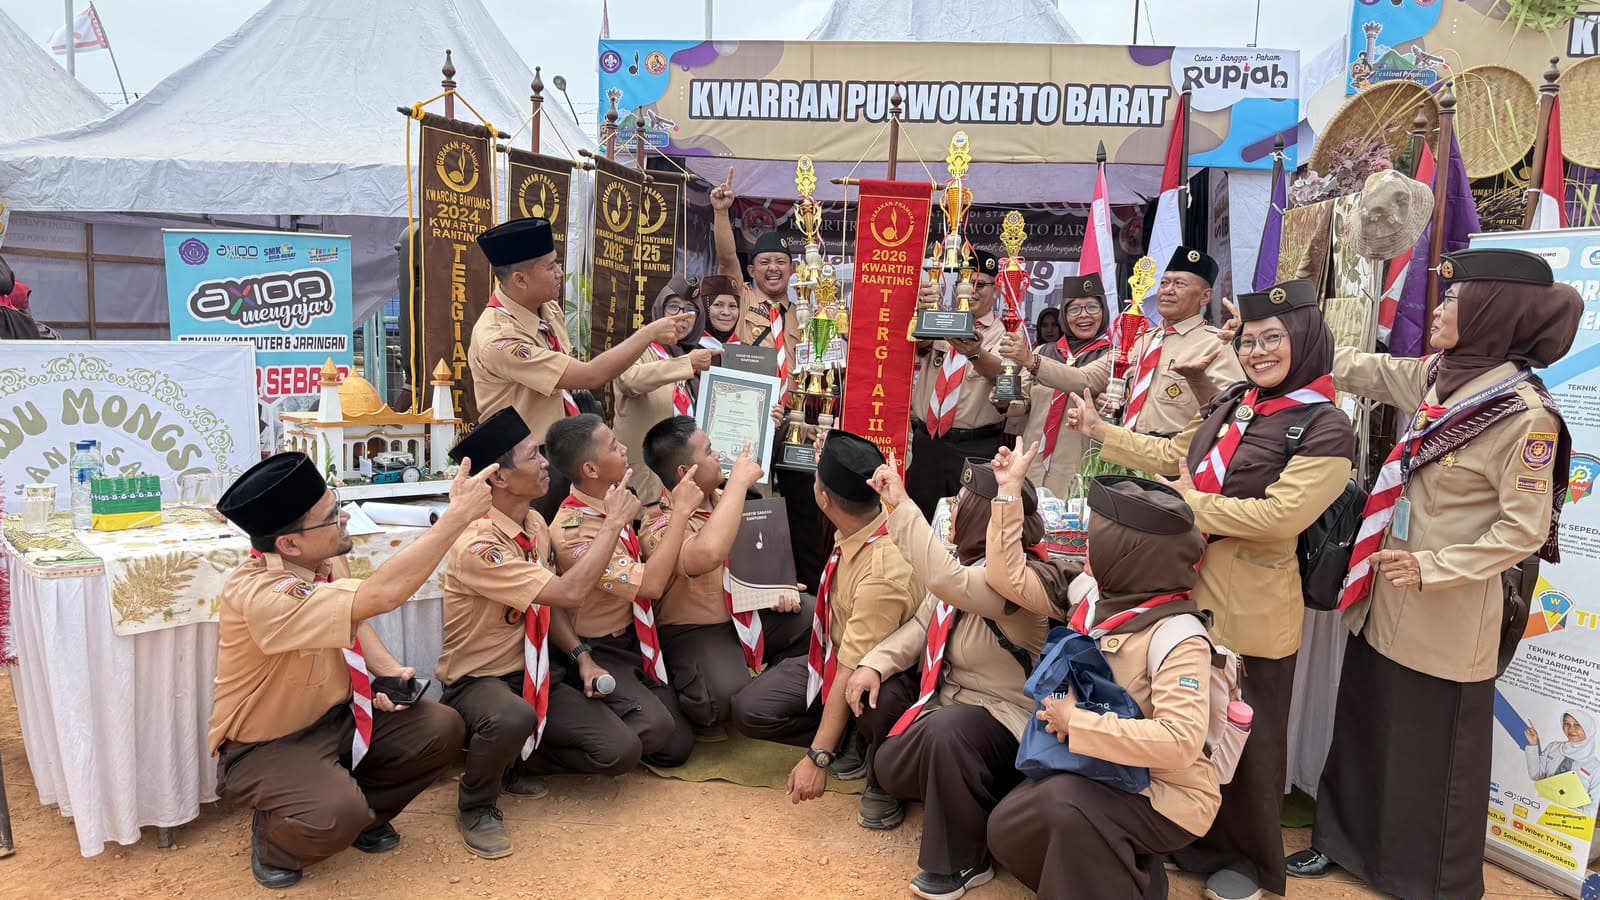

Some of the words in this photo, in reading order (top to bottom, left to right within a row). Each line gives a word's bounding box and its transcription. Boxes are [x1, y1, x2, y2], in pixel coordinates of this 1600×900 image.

[1220, 54, 1248, 63] Bangga
[1183, 63, 1289, 89] Rupiah
[691, 80, 841, 121] KWARRAN
[846, 82, 1058, 125] PURWOKERTO
[1065, 86, 1171, 126] BARAT
[436, 141, 459, 166] GERAKAN
[461, 142, 480, 173] PRAMUKA
[460, 194, 490, 210] BANYUMAS
[437, 204, 480, 223] 2024
[985, 211, 1007, 219] STA
[429, 217, 487, 233] KWARTIR
[1054, 223, 1085, 237] BAR
[642, 235, 673, 245] BANYUMAS
[264, 246, 281, 256] SMK
[603, 239, 624, 262] 2025
[634, 243, 661, 262] 025
[871, 249, 907, 262] 2026
[644, 261, 671, 272] RANTING
[861, 263, 914, 275] KWARTIR
[861, 274, 913, 286] RANTING
[242, 297, 331, 328] mengajar
[451, 243, 468, 380] TERGIAT
[285, 337, 291, 350] &
[293, 337, 346, 350] JARINGAN
[872, 289, 893, 416] TERGIAT
[1567, 383, 1598, 391] TEKNIK
[868, 418, 884, 432] II
[1568, 524, 1600, 535] SEPED
[1526, 653, 1544, 664] DAN
[1545, 658, 1589, 676] JARINGAN
[1527, 644, 1558, 658] TEKNIK
[1558, 654, 1600, 671] KOMPUTE
[1524, 826, 1545, 839] Wiber
[1546, 835, 1555, 843] TV
[1556, 839, 1572, 851] 1958
